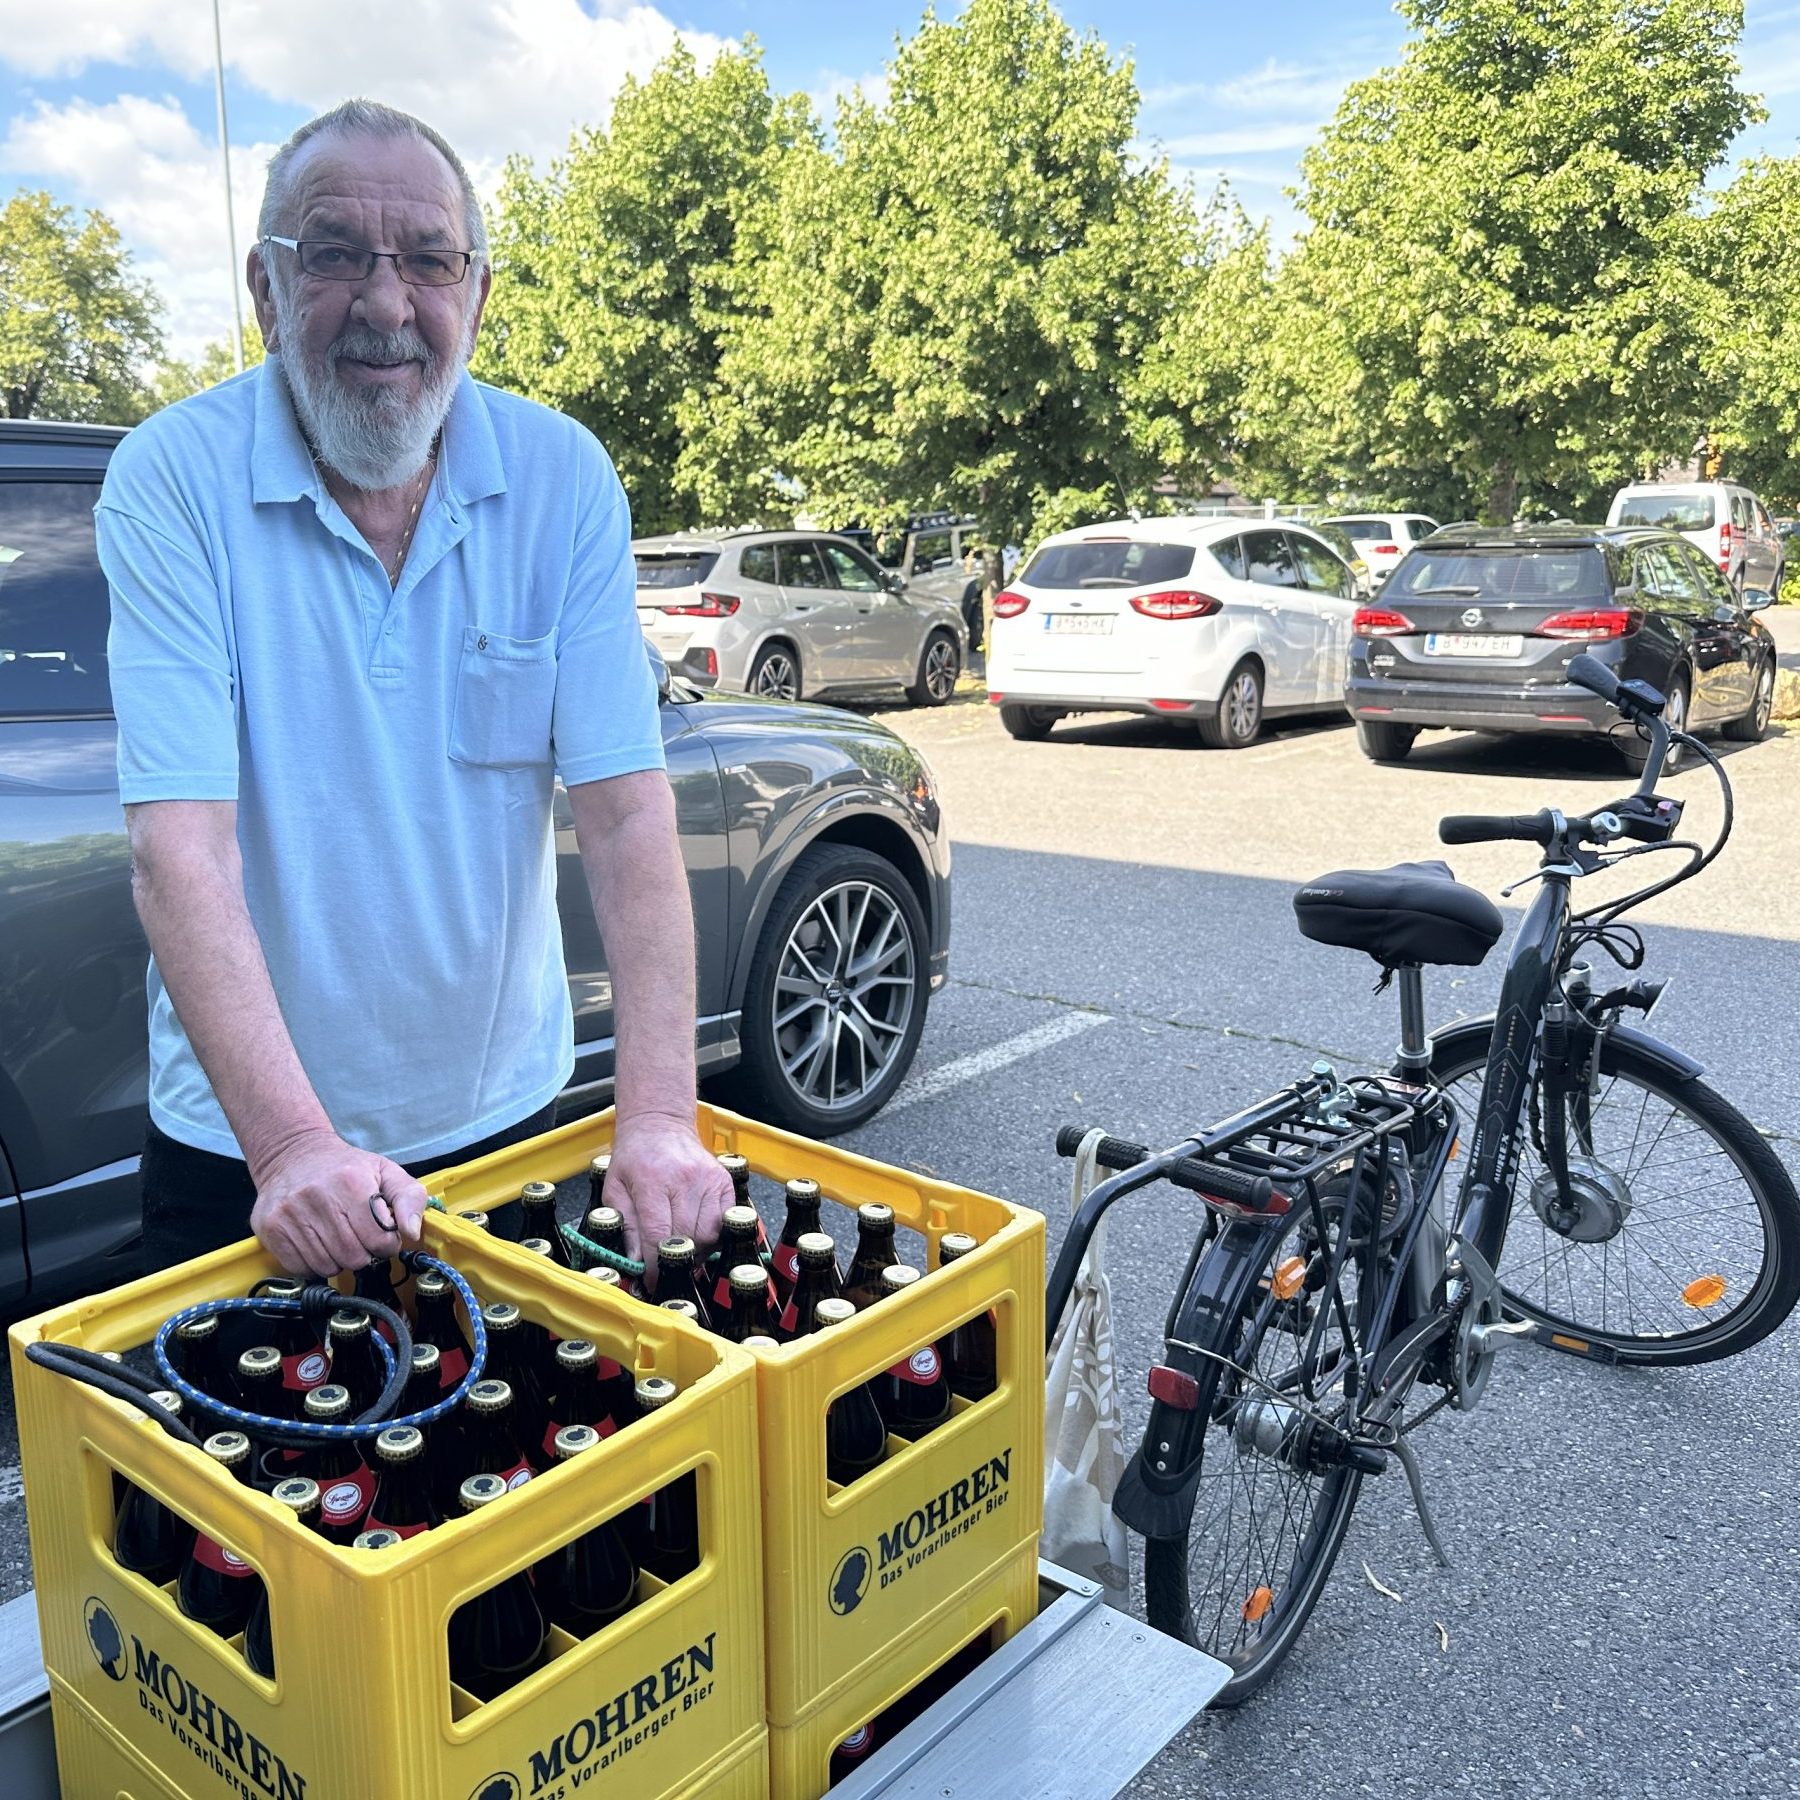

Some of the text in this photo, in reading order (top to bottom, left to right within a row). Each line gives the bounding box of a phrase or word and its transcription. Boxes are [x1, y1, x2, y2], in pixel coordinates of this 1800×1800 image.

[877, 1447, 1012, 1571] MOHREN
[880, 1490, 1009, 1590] Das Vorarlberger Bier
[130, 1634, 307, 1800] MOHREN
[138, 1687, 164, 1725] Das
[528, 1631, 717, 1796] MOHREN
[571, 1706, 677, 1789] Vorarlberger
[683, 1680, 715, 1712] Bier
